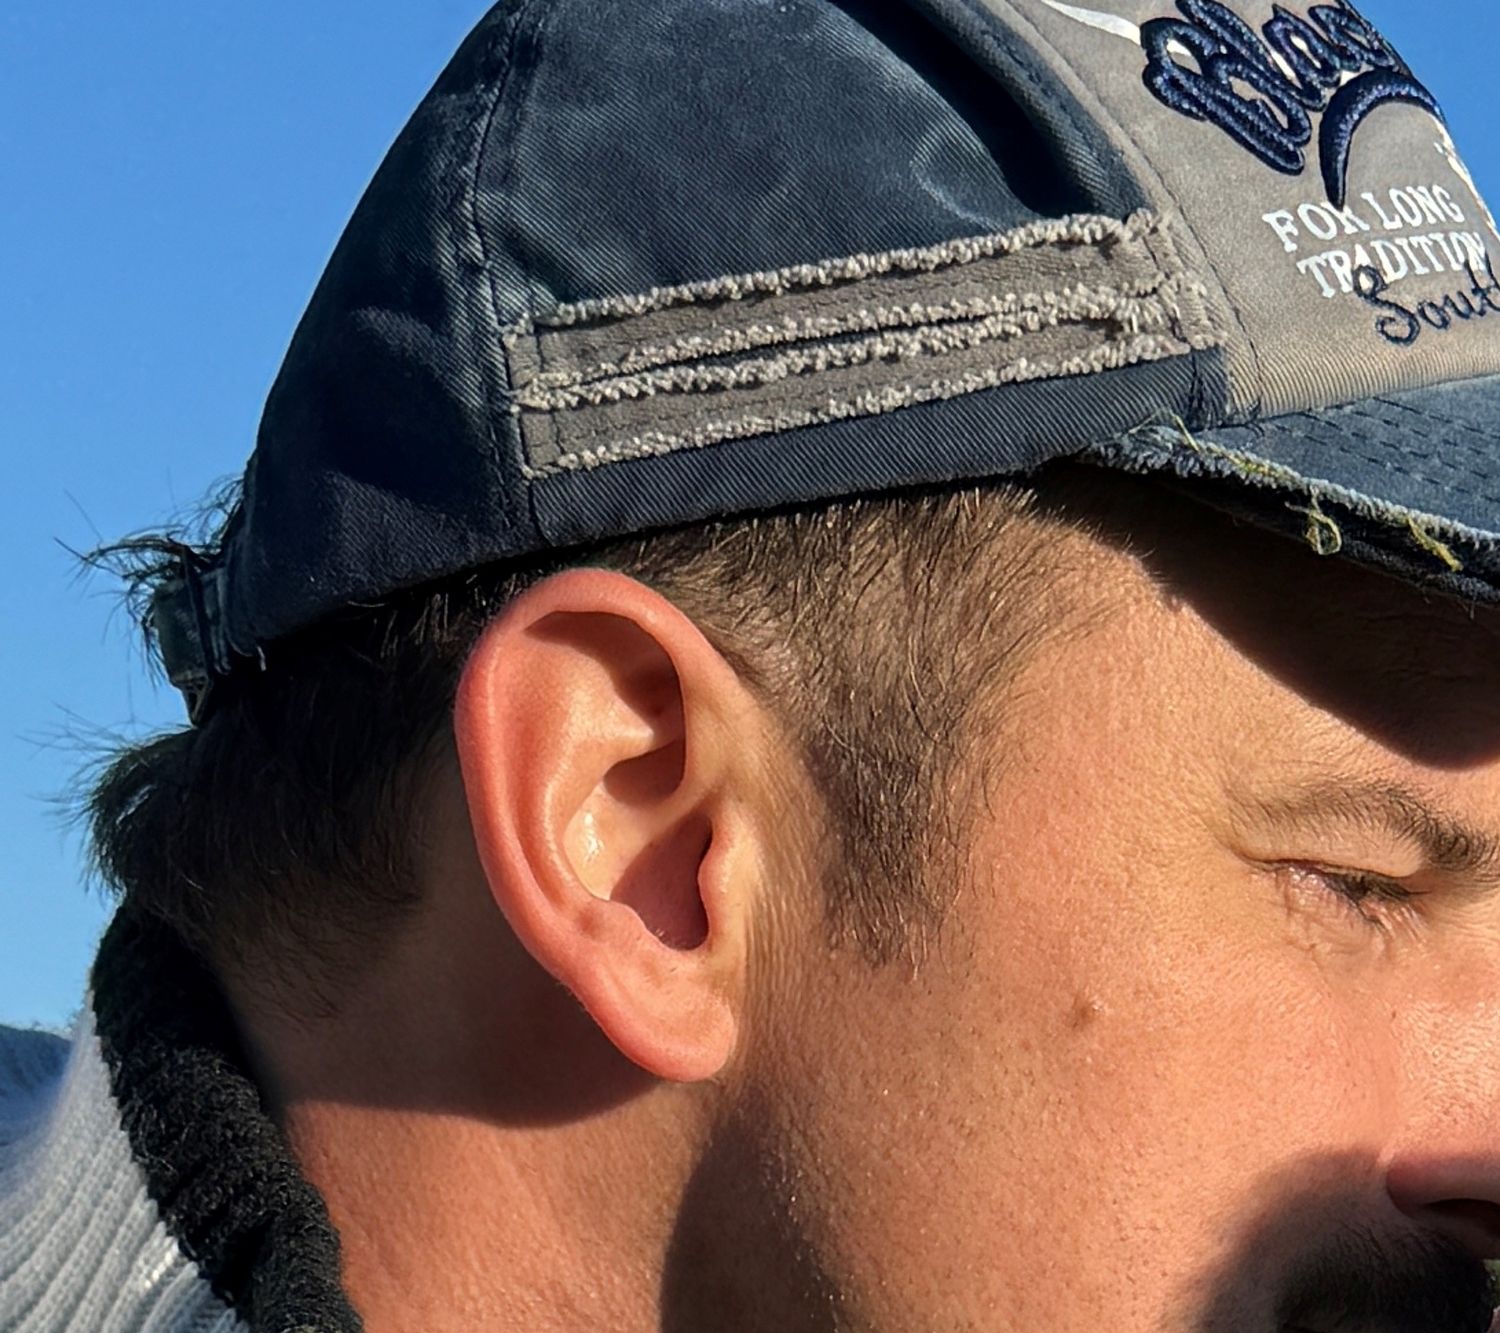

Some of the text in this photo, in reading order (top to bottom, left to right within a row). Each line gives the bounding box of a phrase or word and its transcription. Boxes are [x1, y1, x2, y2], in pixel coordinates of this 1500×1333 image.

[1261, 184, 1465, 253] FOR LONG
[1296, 230, 1488, 299] TRADITION
